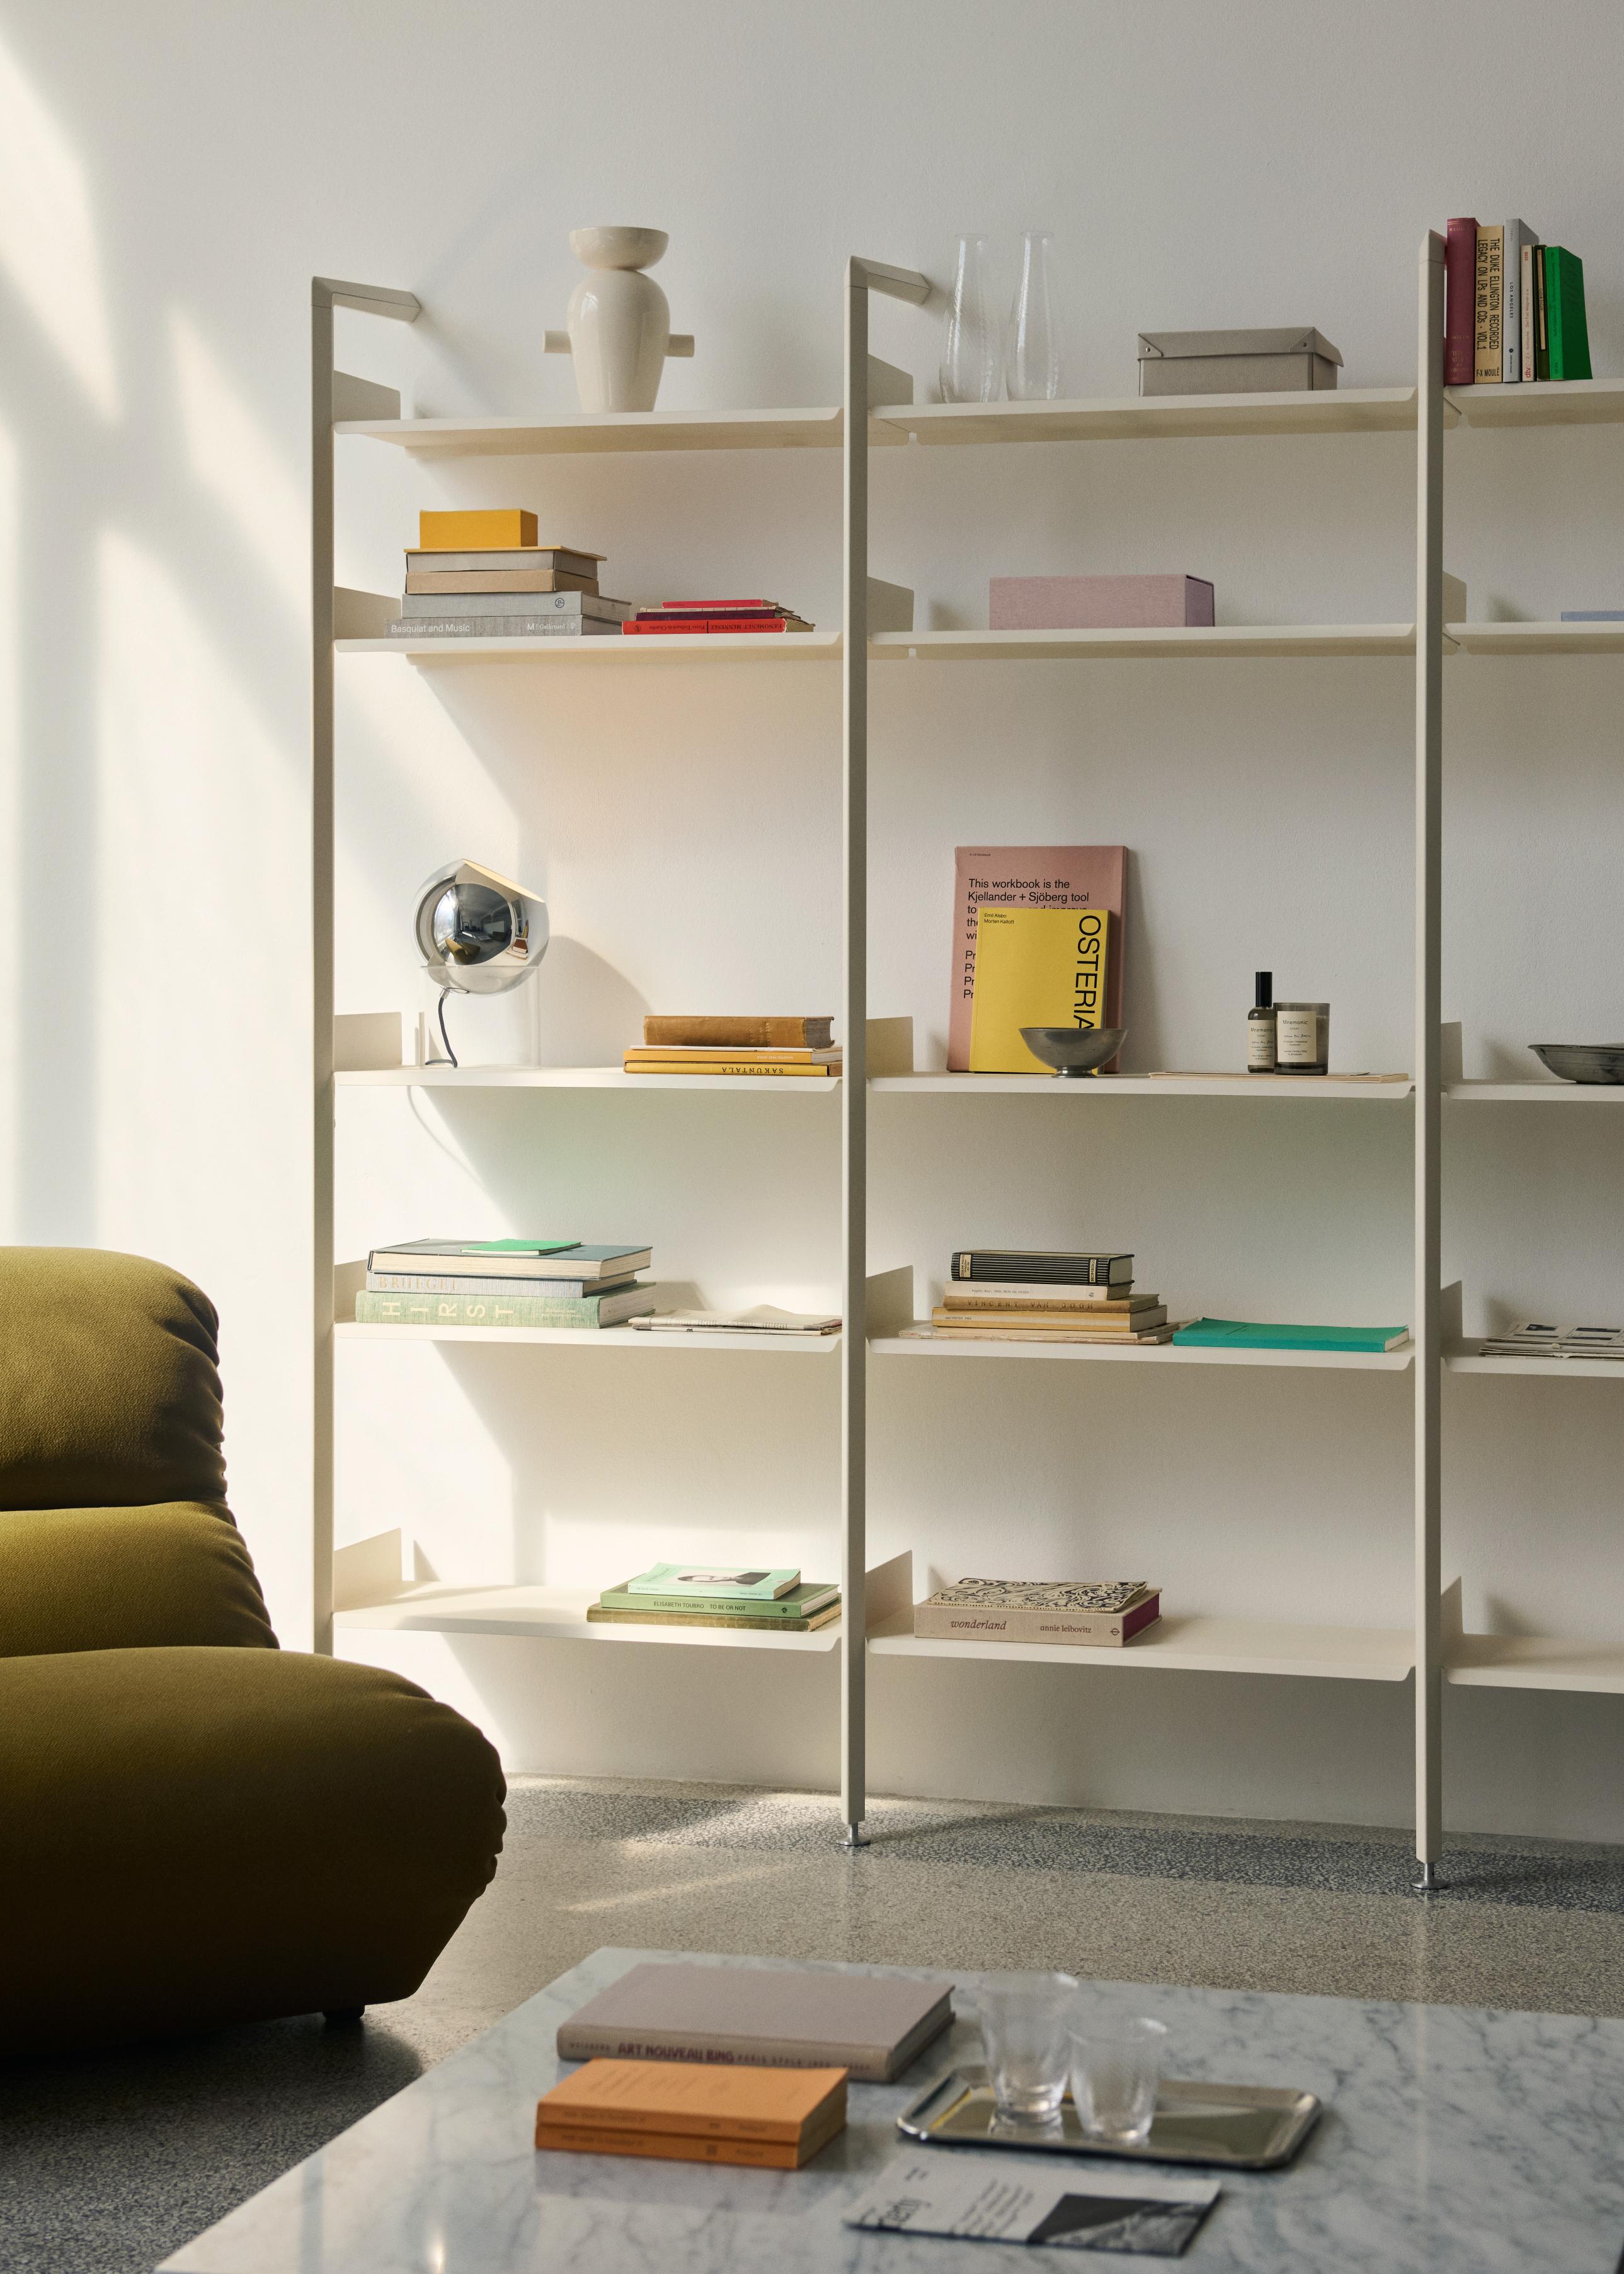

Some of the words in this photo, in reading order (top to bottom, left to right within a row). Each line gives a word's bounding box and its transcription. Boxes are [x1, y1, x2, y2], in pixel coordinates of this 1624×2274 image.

[1477, 239, 1488, 263] LEGACY
[1490, 238, 1500, 251] THE
[1490, 255, 1500, 272] DUKE
[1477, 267, 1488, 276] ON
[1489, 275, 1500, 311] ELLINGTON
[1477, 294, 1487, 307] AND
[1489, 314, 1499, 350] RECORDED
[1477, 331, 1487, 350] VOL.1
[1484, 367, 1499, 377] MOULÉ
[391, 624, 427, 633] Basquiat
[969, 878, 989, 888] This
[992, 878, 1040, 888] workbook
[1043, 879, 1051, 888] is
[1055, 879, 1070, 888] the
[968, 891, 1017, 904] Kjellander
[1029, 892, 1068, 904] Sjöberg
[1071, 892, 1089, 902] tool
[967, 905, 977, 914] to
[1073, 915, 1102, 1029] OSTERIA
[379, 1277, 459, 1291] BRUEGEL
[382, 1301, 513, 1319] HIRST
[950, 1619, 1007, 1631] wonderland
[1061, 1624, 1092, 1633] leibovitz
[618, 2041, 642, 2056] ART
[646, 2043, 703, 2060] NOUVEAU
[706, 2050, 735, 2063] BING
